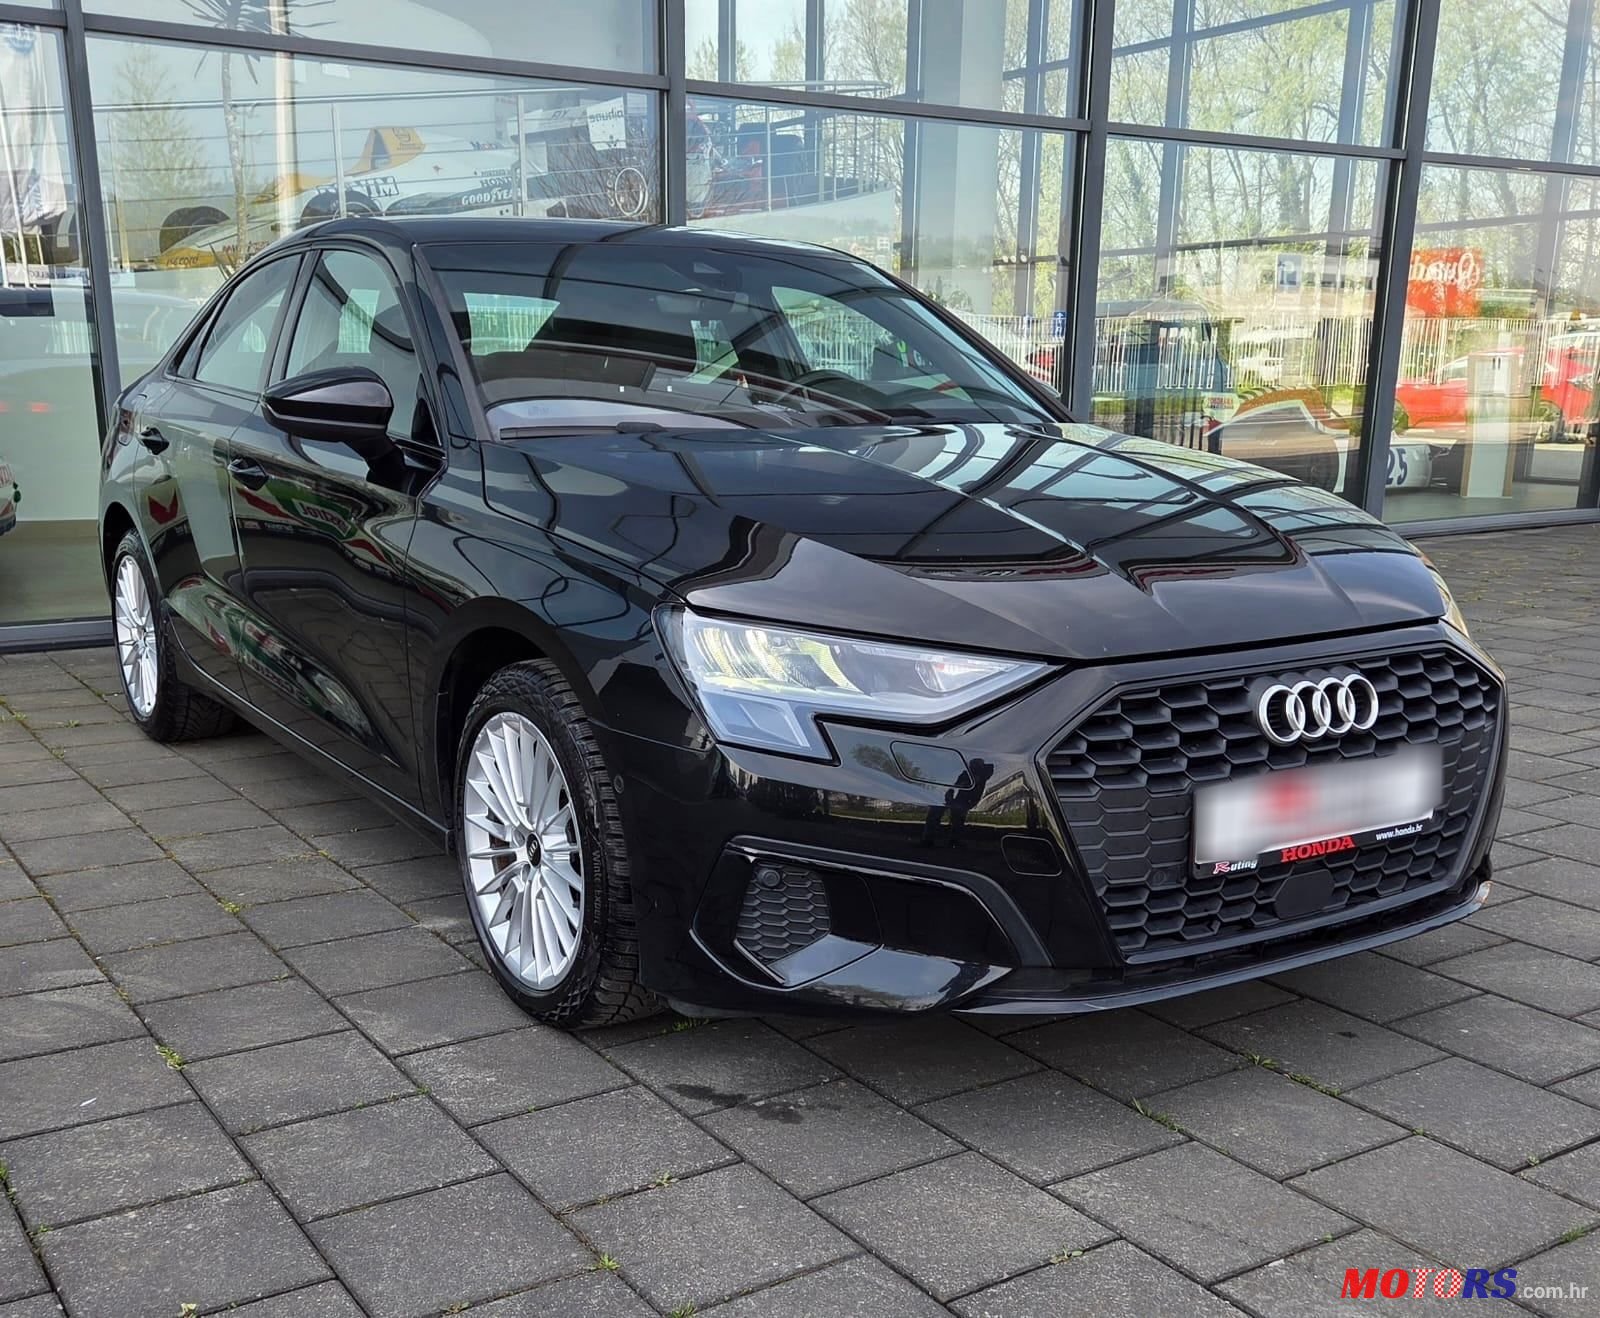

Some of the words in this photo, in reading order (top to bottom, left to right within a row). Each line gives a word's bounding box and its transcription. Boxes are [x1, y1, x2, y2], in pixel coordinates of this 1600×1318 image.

[461, 187, 521, 206] GOODYE
[1281, 836, 1354, 862] HONDA
[1212, 859, 1258, 875] Ruting
